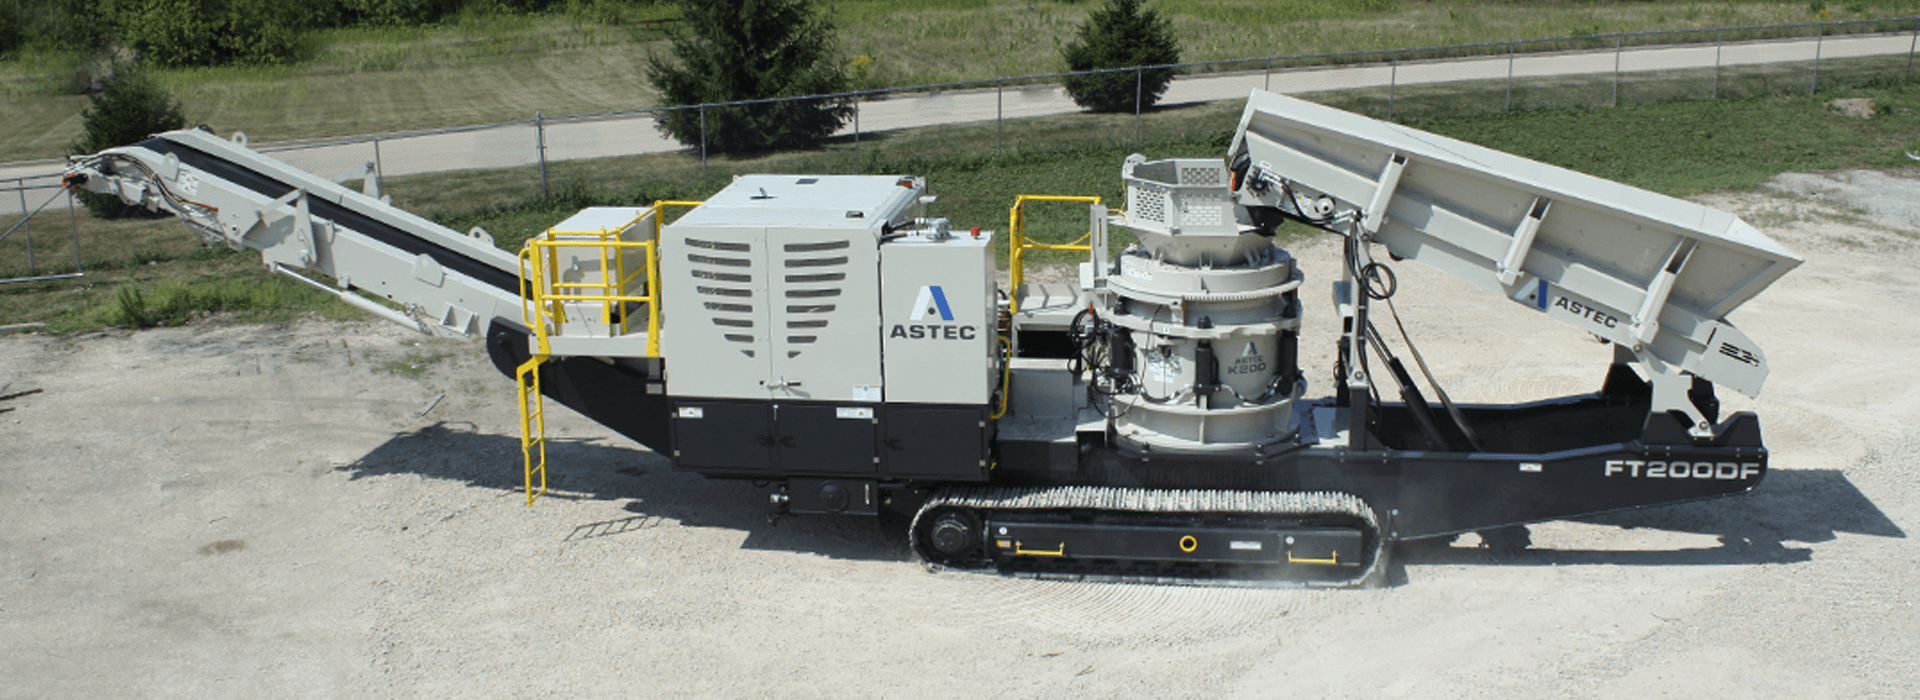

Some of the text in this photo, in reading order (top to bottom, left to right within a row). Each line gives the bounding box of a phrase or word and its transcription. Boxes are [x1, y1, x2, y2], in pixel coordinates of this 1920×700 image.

[1555, 296, 1618, 329] ASTEC
[890, 324, 976, 341] ASTEC
[1228, 362, 1267, 375] K200
[1604, 460, 1760, 480] FT200DF
